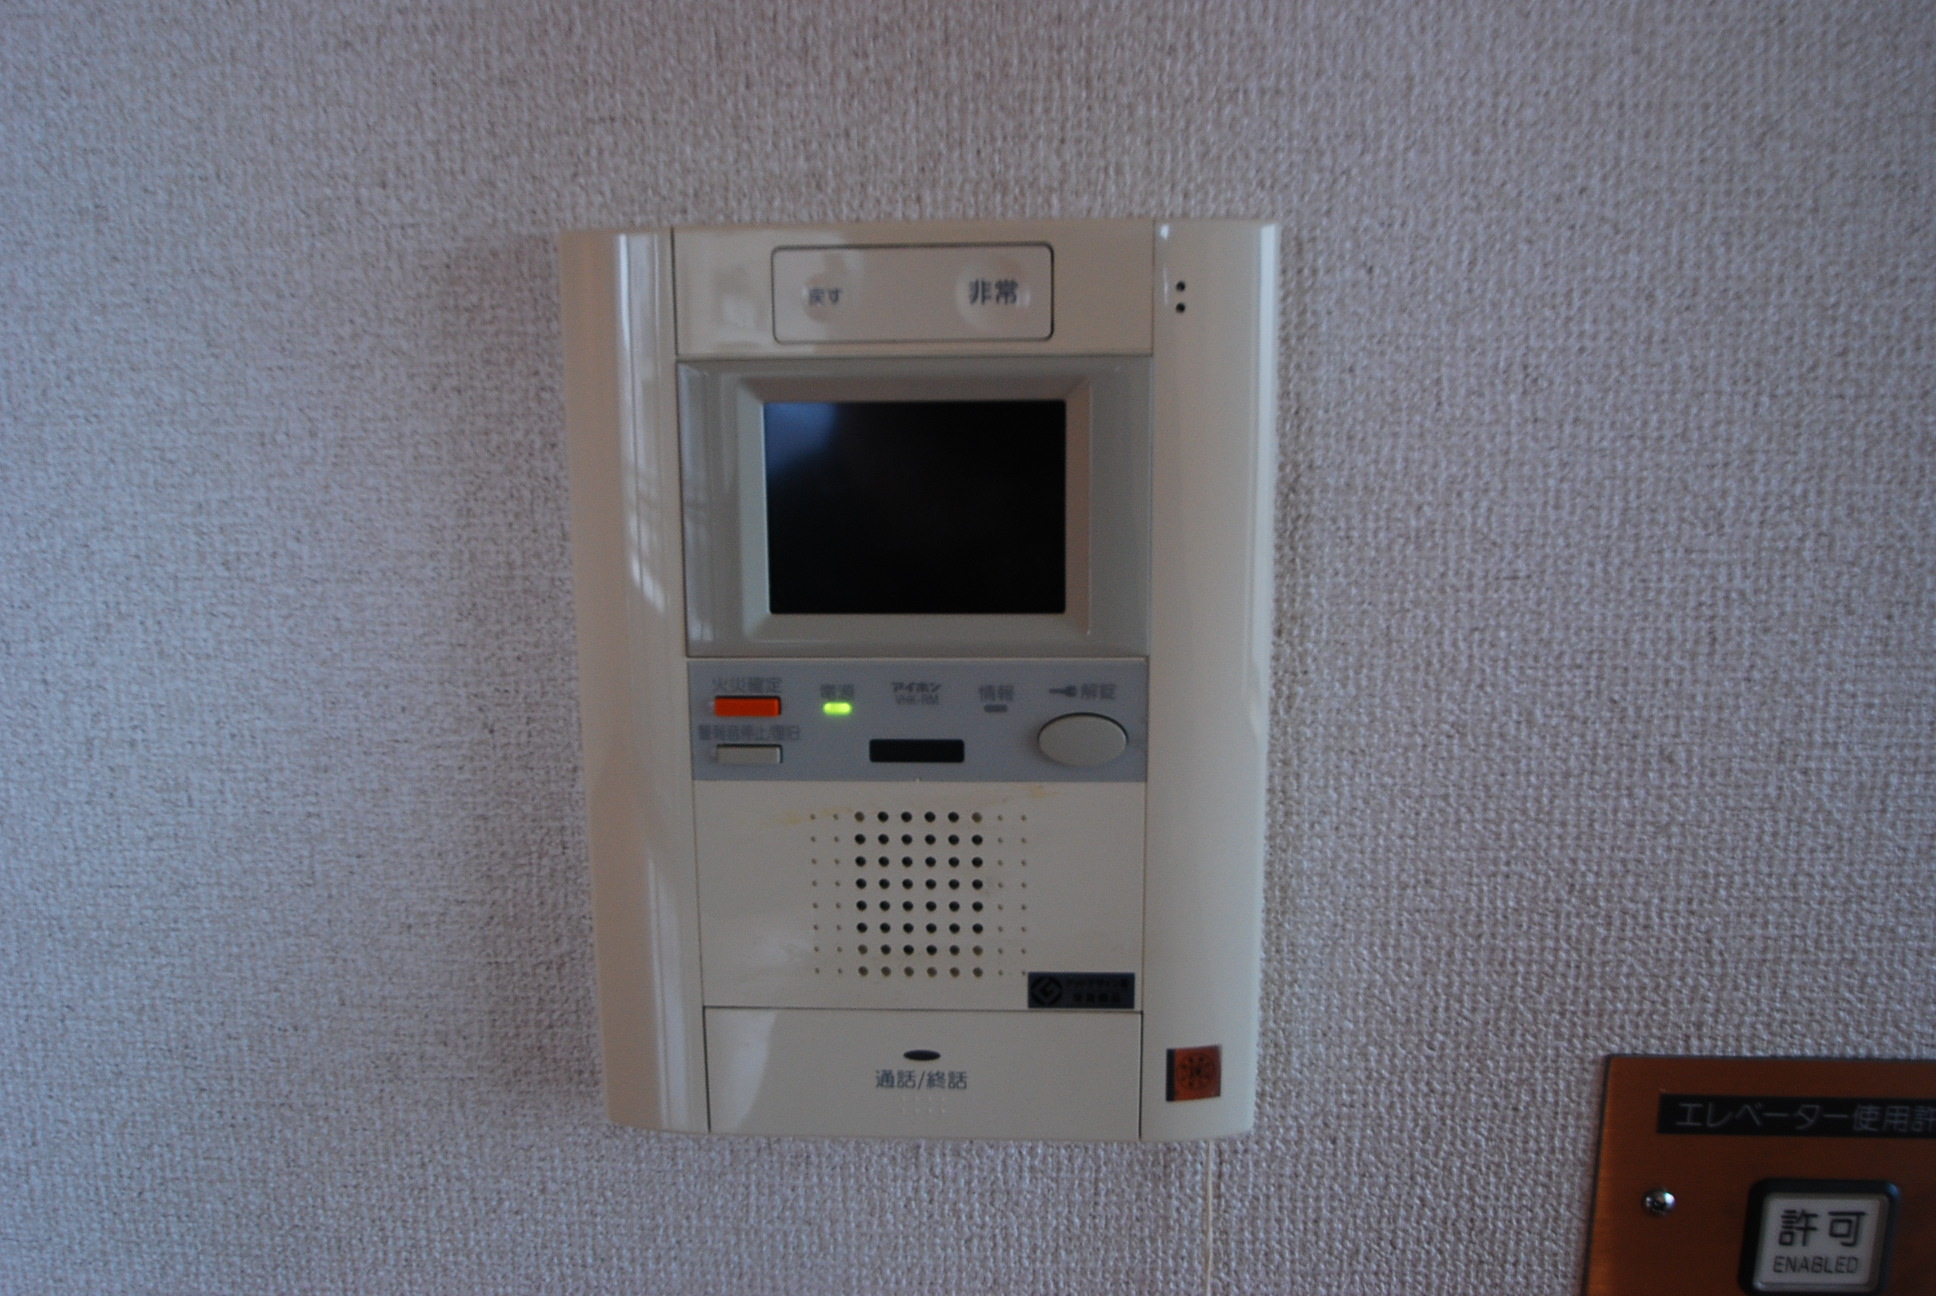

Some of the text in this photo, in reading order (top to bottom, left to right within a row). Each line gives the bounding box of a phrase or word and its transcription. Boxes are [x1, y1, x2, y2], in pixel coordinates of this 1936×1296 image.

[968, 278, 1018, 305] 非常
[875, 1069, 967, 1090] 通話/終話
[1778, 1208, 1867, 1247] 許可
[1772, 1255, 1858, 1274] ENABLED
